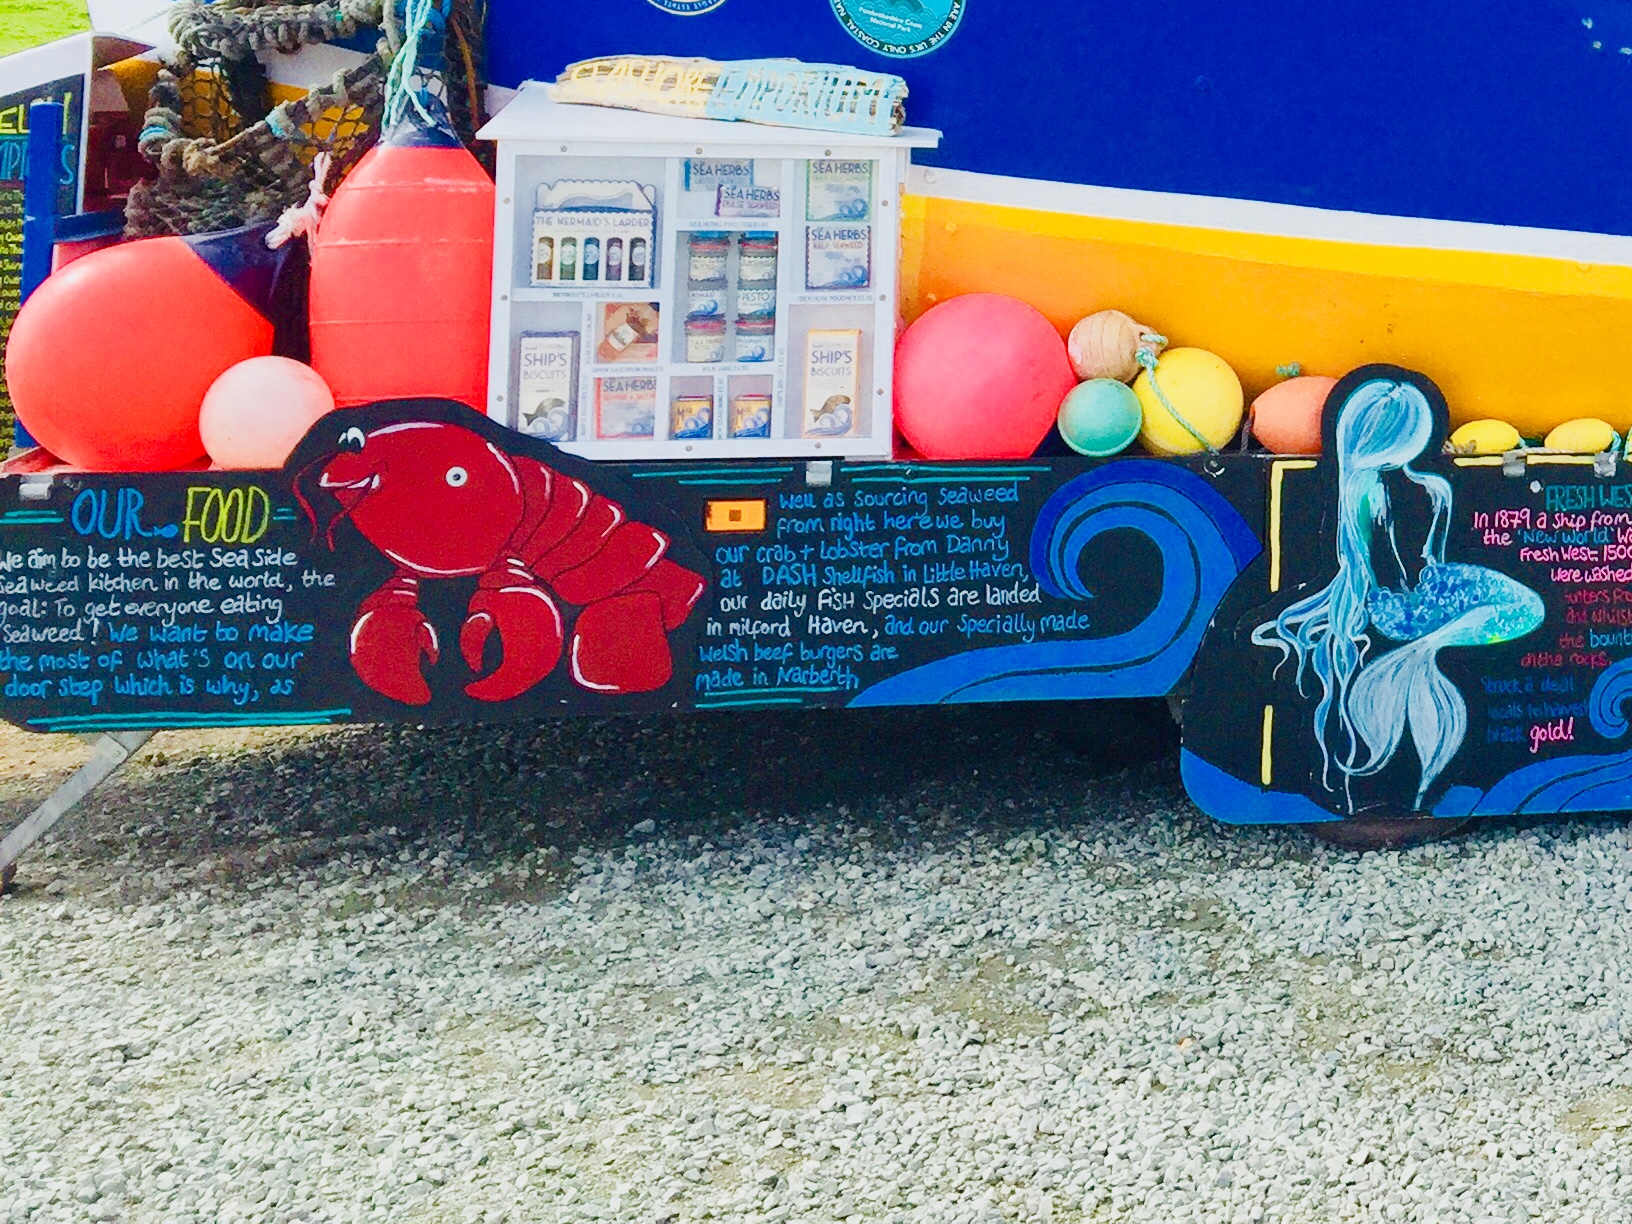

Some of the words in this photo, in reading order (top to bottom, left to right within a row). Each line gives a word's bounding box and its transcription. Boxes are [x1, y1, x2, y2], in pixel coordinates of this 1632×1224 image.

[949, 2, 960, 21] ARE
[847, 19, 880, 48] COASTAL
[943, 21, 952, 31] IN
[929, 31, 944, 45] THE
[883, 44, 906, 54] ONLY
[693, 161, 714, 175] SEA
[715, 164, 749, 175] HERBS
[724, 187, 743, 199] SEA
[747, 189, 780, 201] HERBS
[536, 217, 552, 226] THE
[613, 217, 649, 227] LARDER
[812, 351, 852, 364] SHIP'S
[811, 367, 852, 376] BISCUITS
[1546, 484, 1595, 511] FRESH
[71, 487, 153, 540] OUR
[182, 485, 271, 544] FOOD
[1474, 512, 1488, 527] In
[1495, 508, 1531, 527] 1879
[1536, 513, 1547, 526] a
[1591, 510, 1632, 531] from
[118, 548, 152, 568] the
[156, 549, 204, 568] best
[762, 565, 817, 586] DASH
[720, 596, 747, 613] our
[761, 589, 807, 618] daily
[947, 588, 980, 606] are
[985, 583, 1041, 605] landed
[55, 598, 75, 617] To
[84, 594, 120, 628] get
[125, 599, 215, 628] everyone
[220, 597, 282, 624] eating
